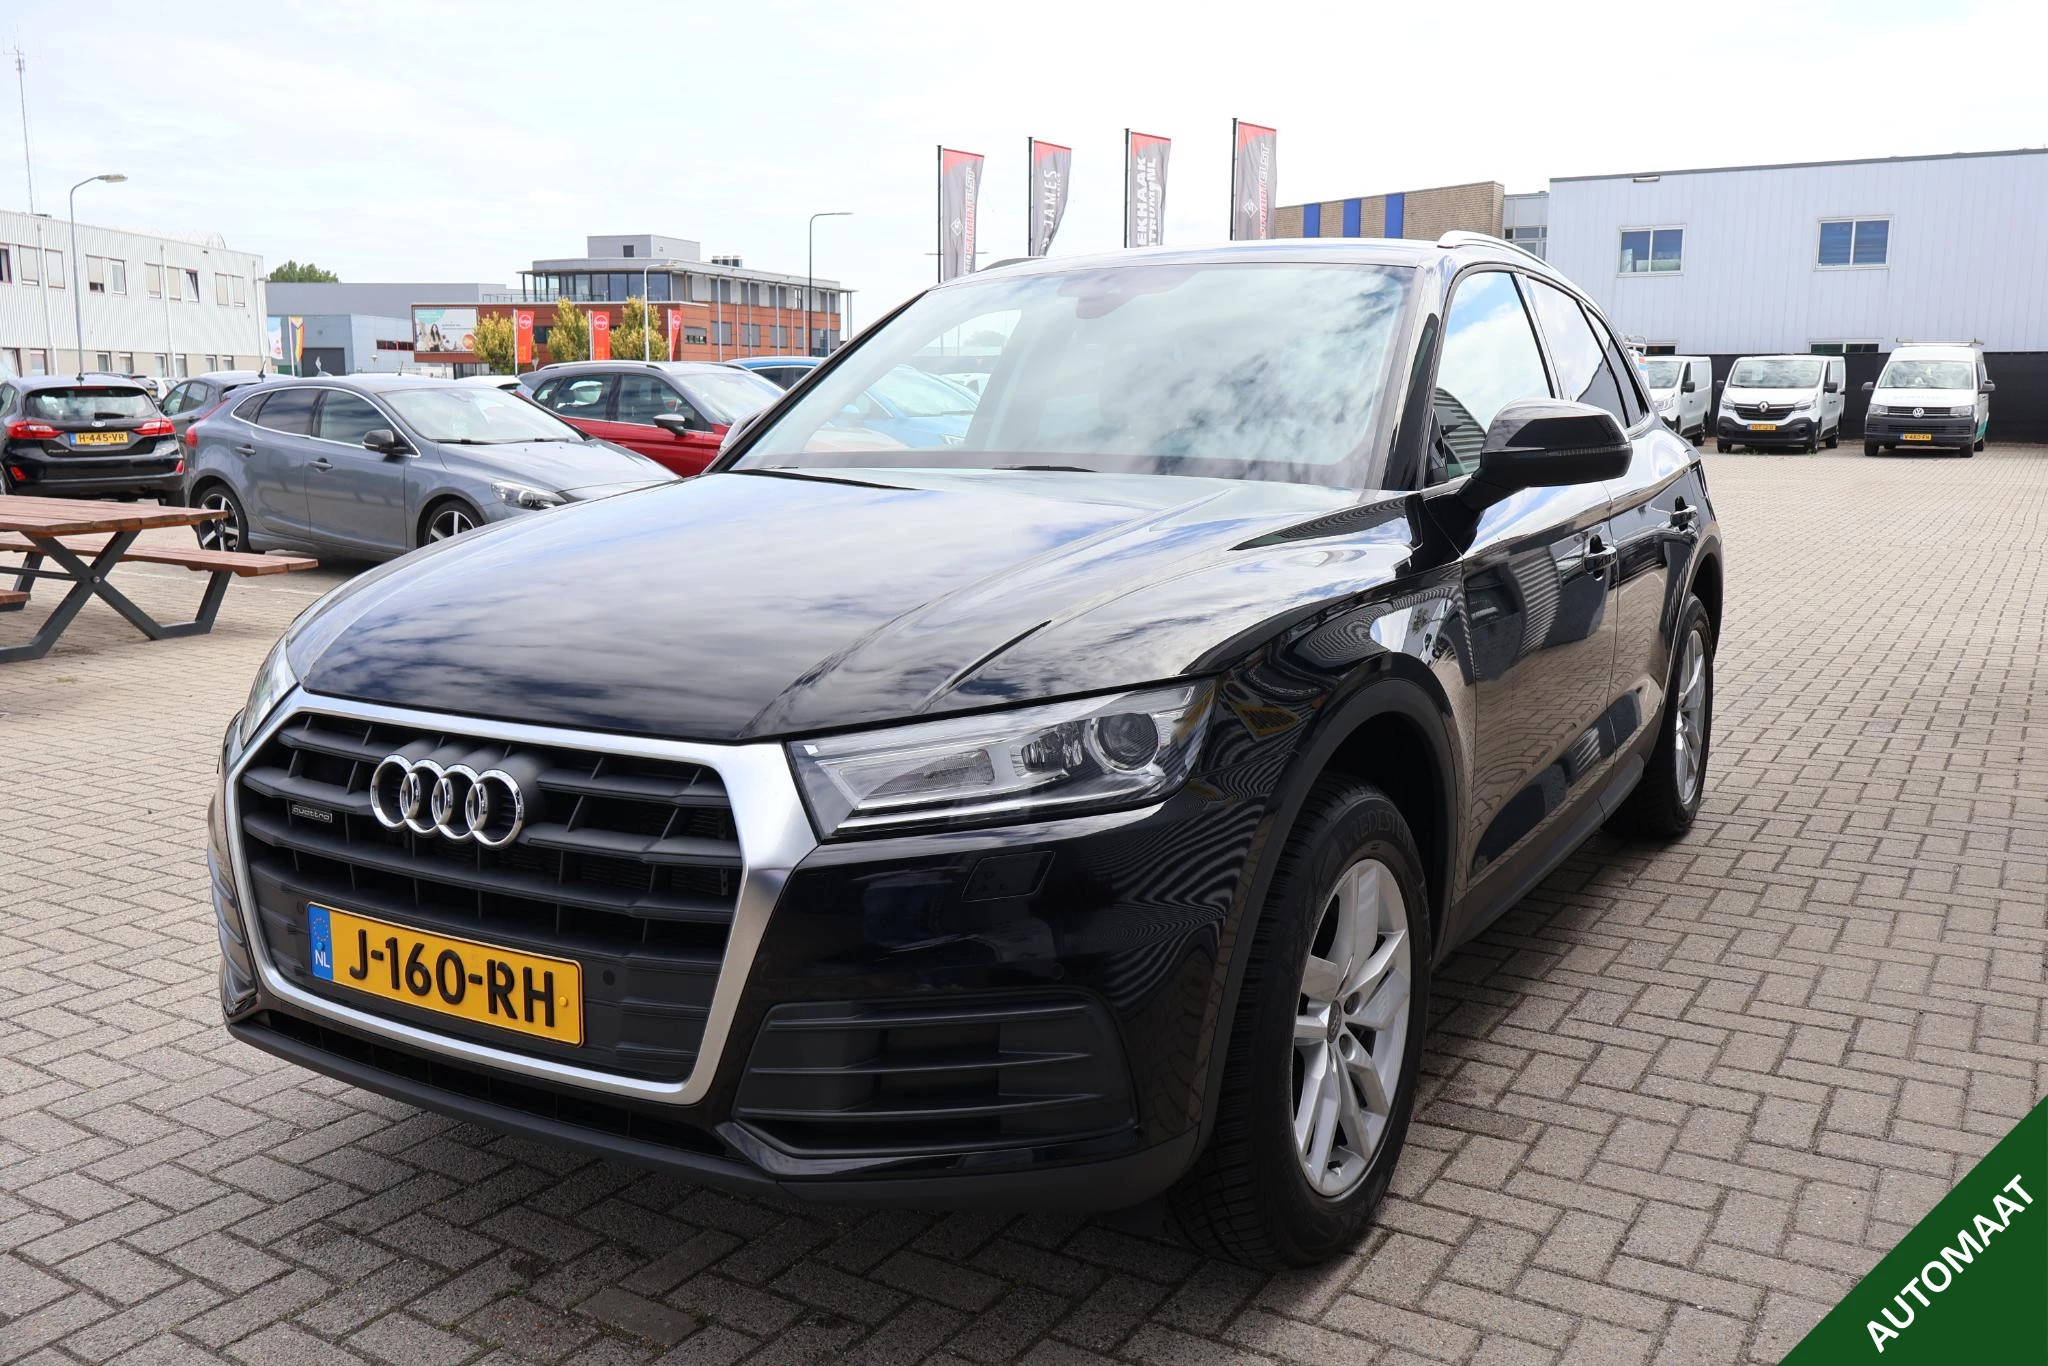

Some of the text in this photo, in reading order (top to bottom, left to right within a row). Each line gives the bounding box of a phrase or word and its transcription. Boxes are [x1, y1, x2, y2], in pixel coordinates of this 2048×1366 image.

[1043, 169, 1057, 229] JAMES
[79, 433, 125, 443] H-445-VR
[292, 807, 330, 821] quattro
[315, 928, 555, 1028] NL J-160-RH
